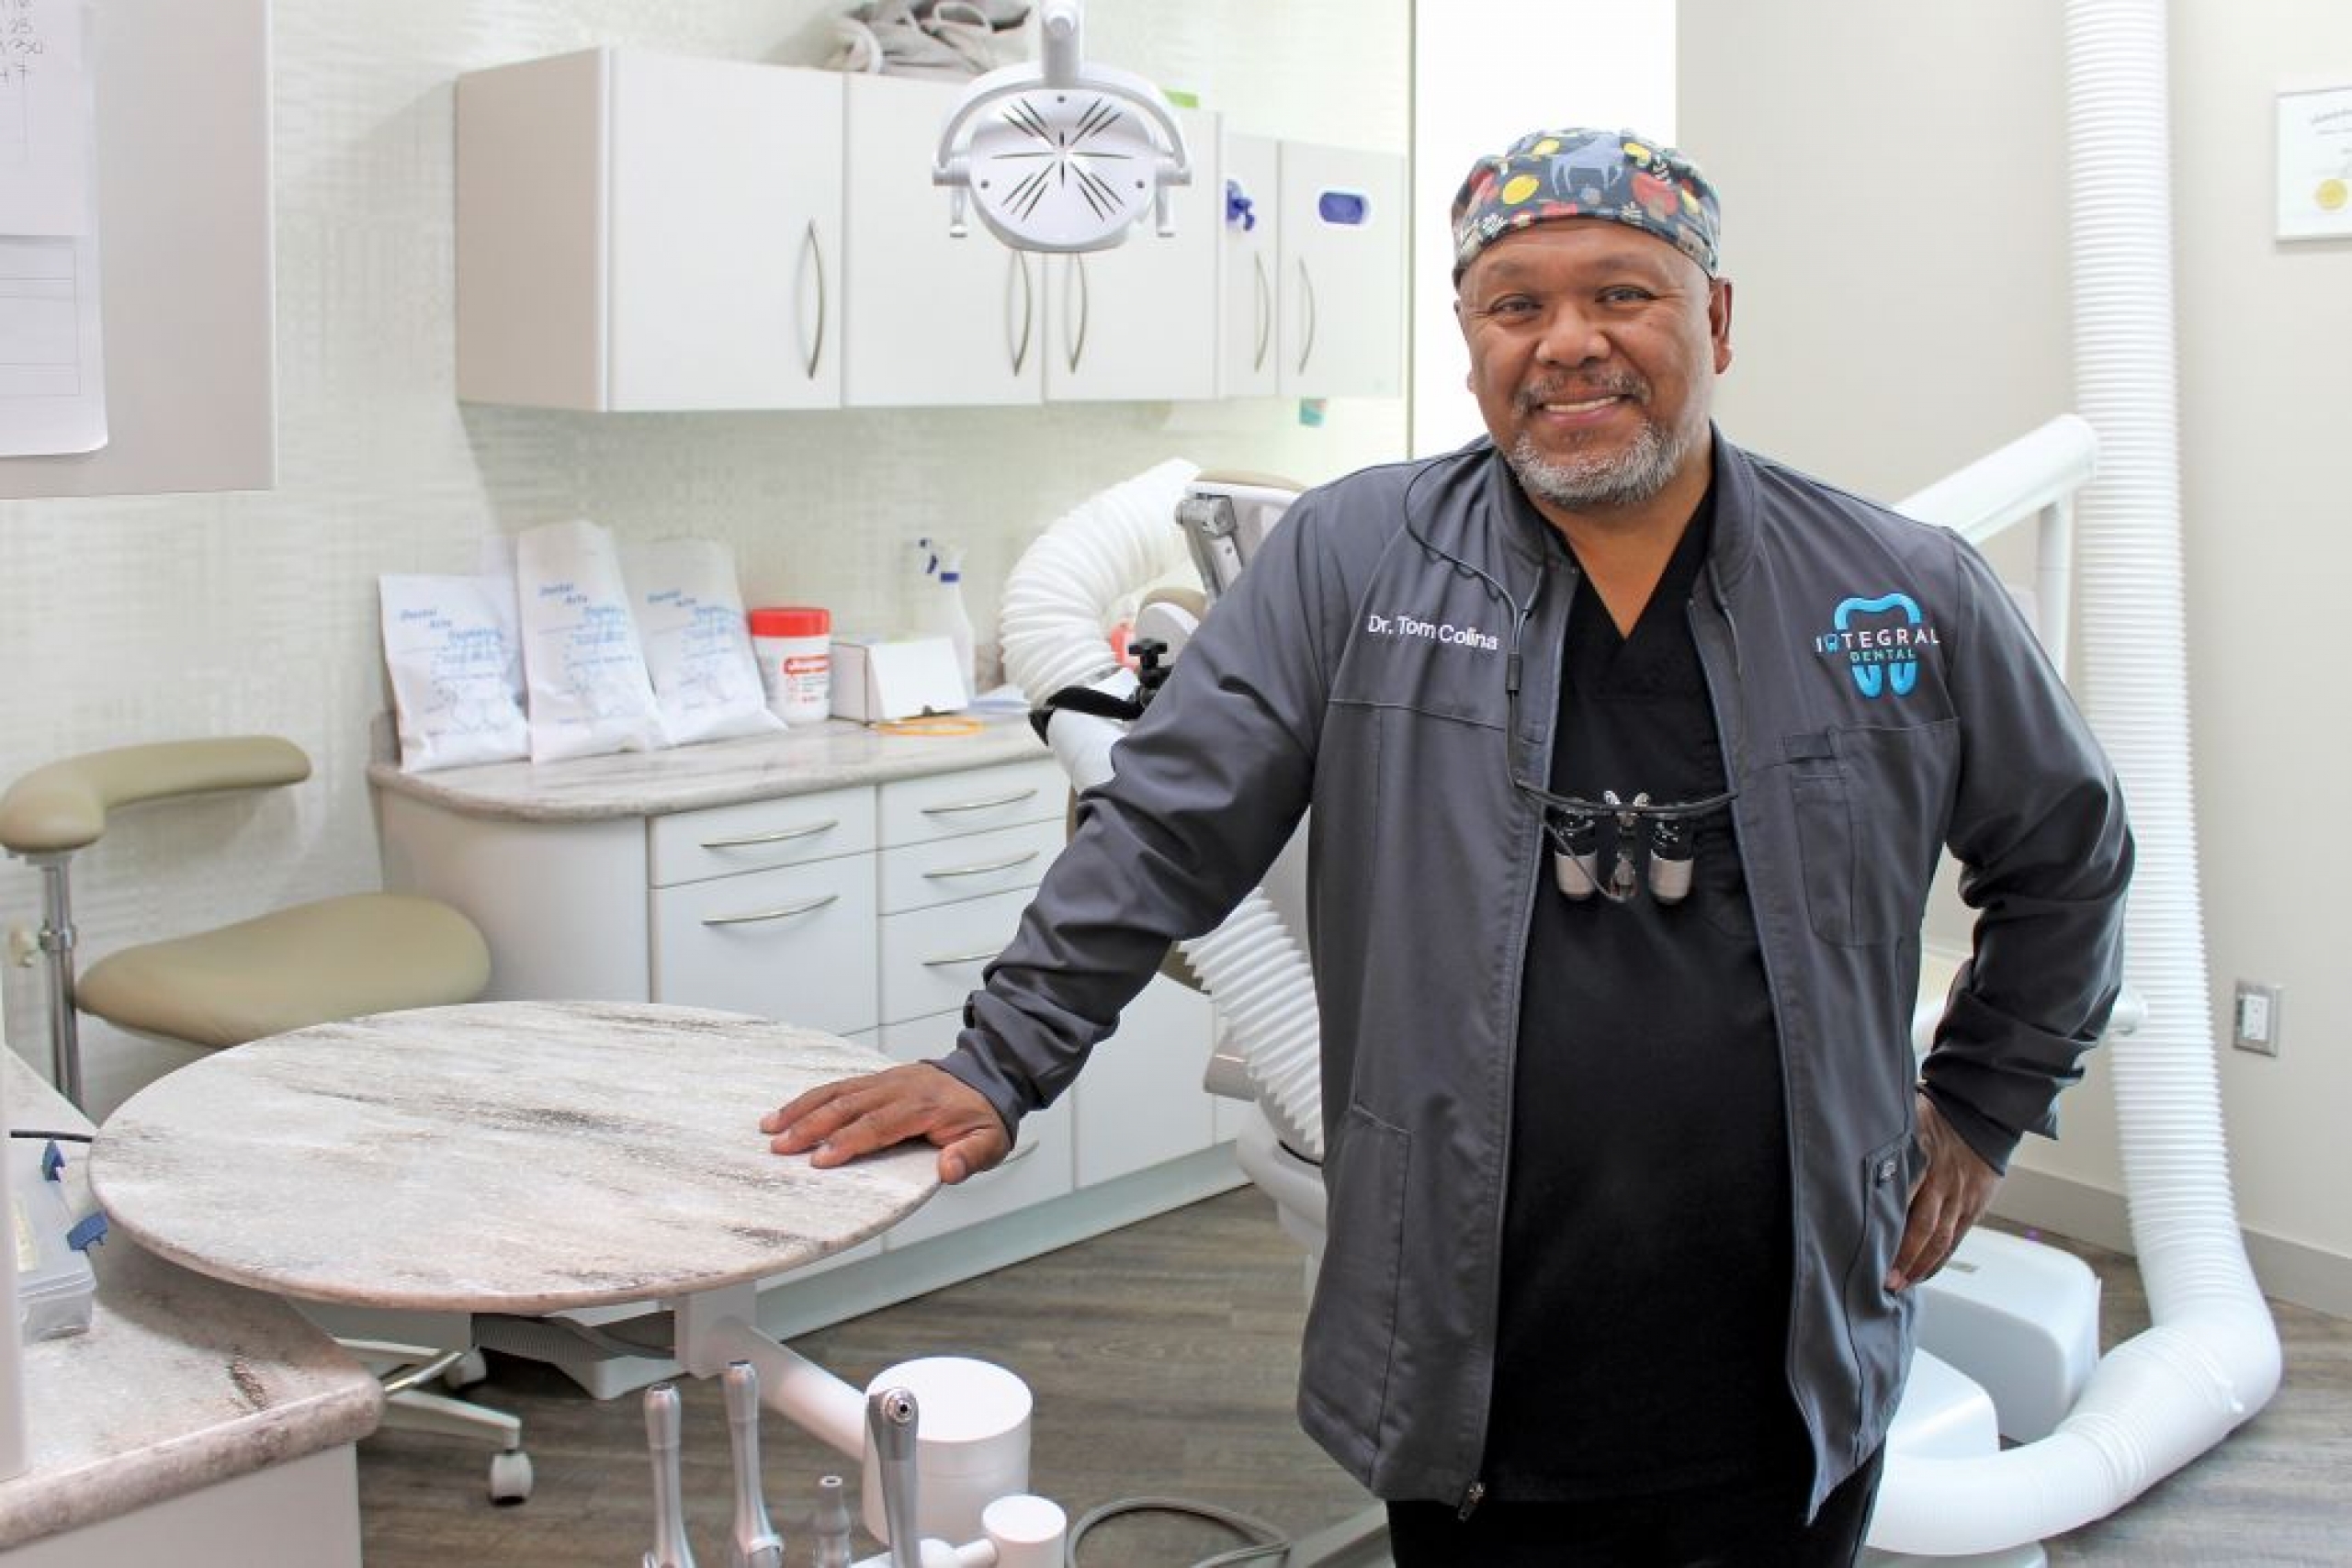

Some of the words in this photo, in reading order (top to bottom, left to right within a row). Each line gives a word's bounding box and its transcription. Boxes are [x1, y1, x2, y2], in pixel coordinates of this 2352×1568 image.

[1368, 615, 1393, 634] Dr.
[1396, 615, 1435, 638] Tom
[1440, 625, 1498, 649] Colina
[1850, 649, 1917, 663] DENTAL
